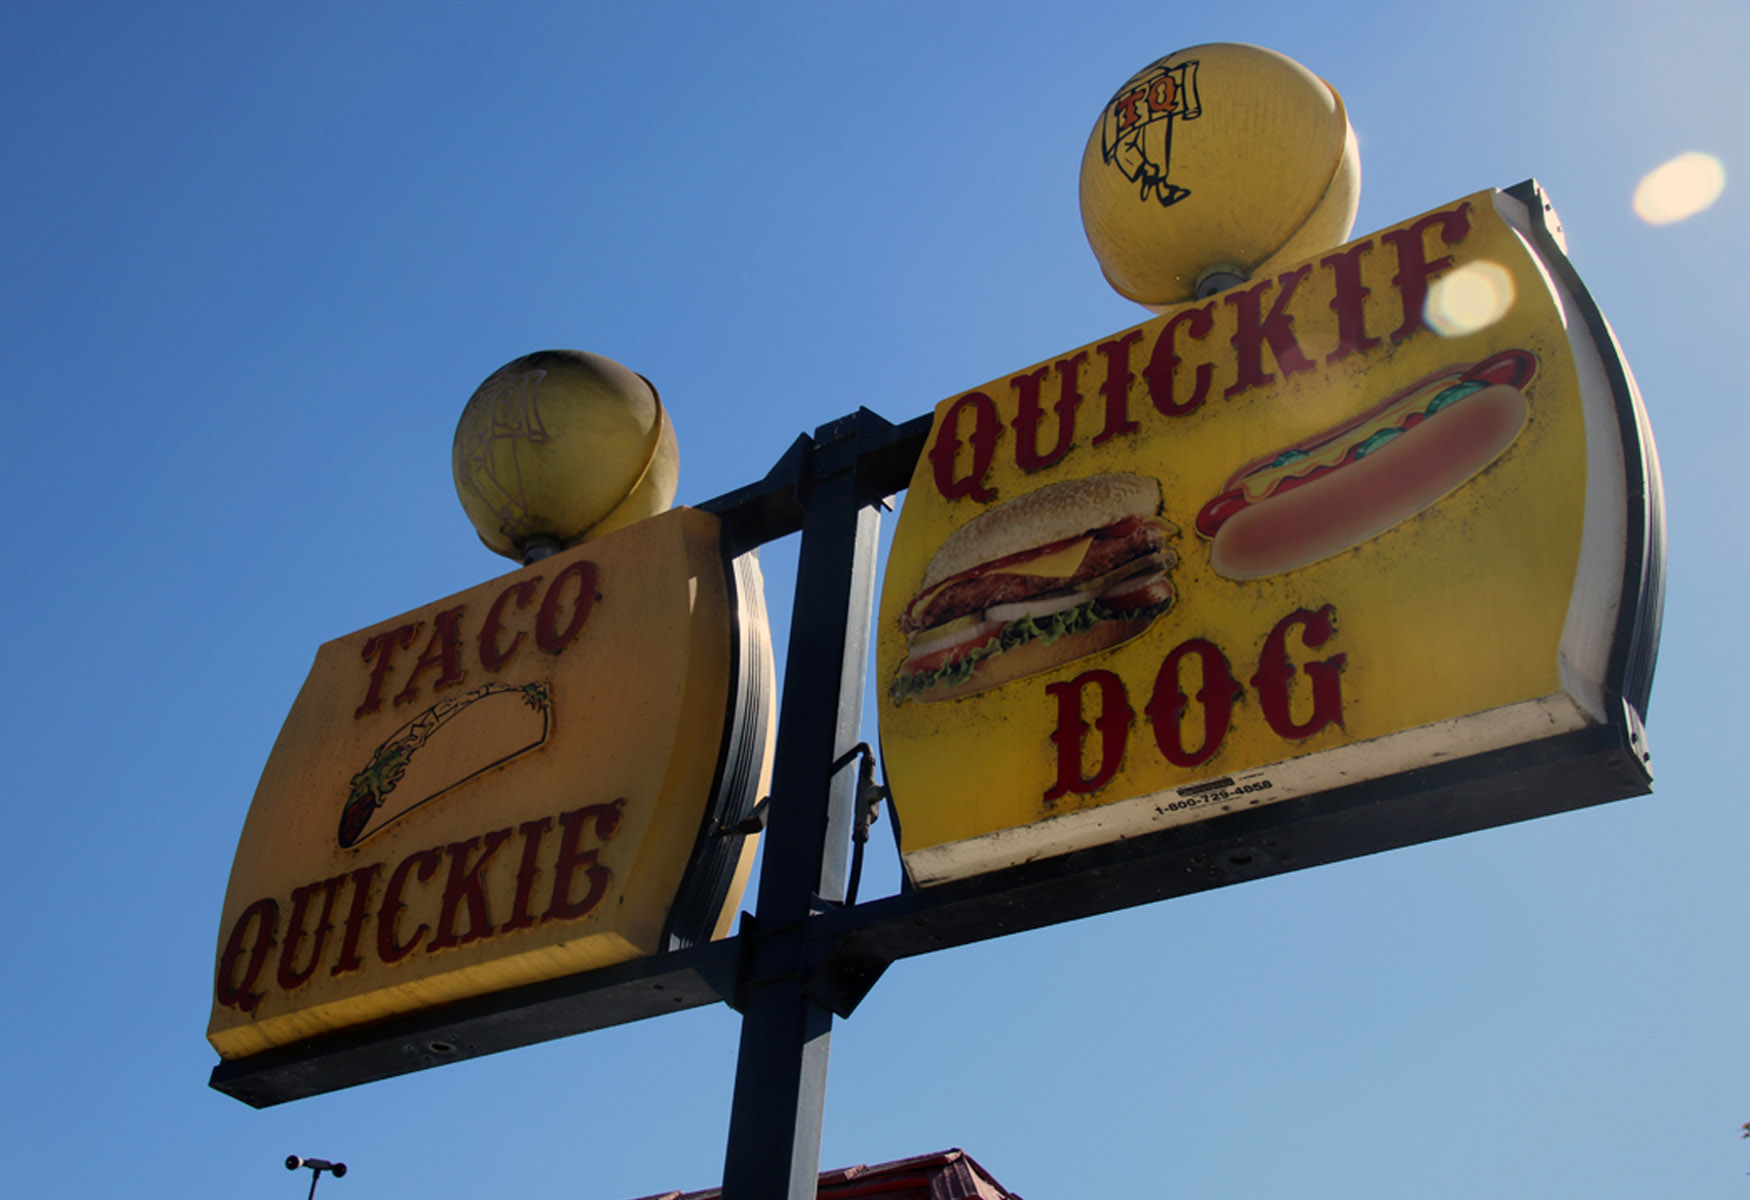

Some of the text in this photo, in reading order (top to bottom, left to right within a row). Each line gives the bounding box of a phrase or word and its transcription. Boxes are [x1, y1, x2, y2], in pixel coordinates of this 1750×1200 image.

[1114, 76, 1179, 129] TQ
[354, 559, 600, 719] TACO
[1043, 602, 1347, 803] DOG
[216, 798, 627, 1013] QUICKIE
